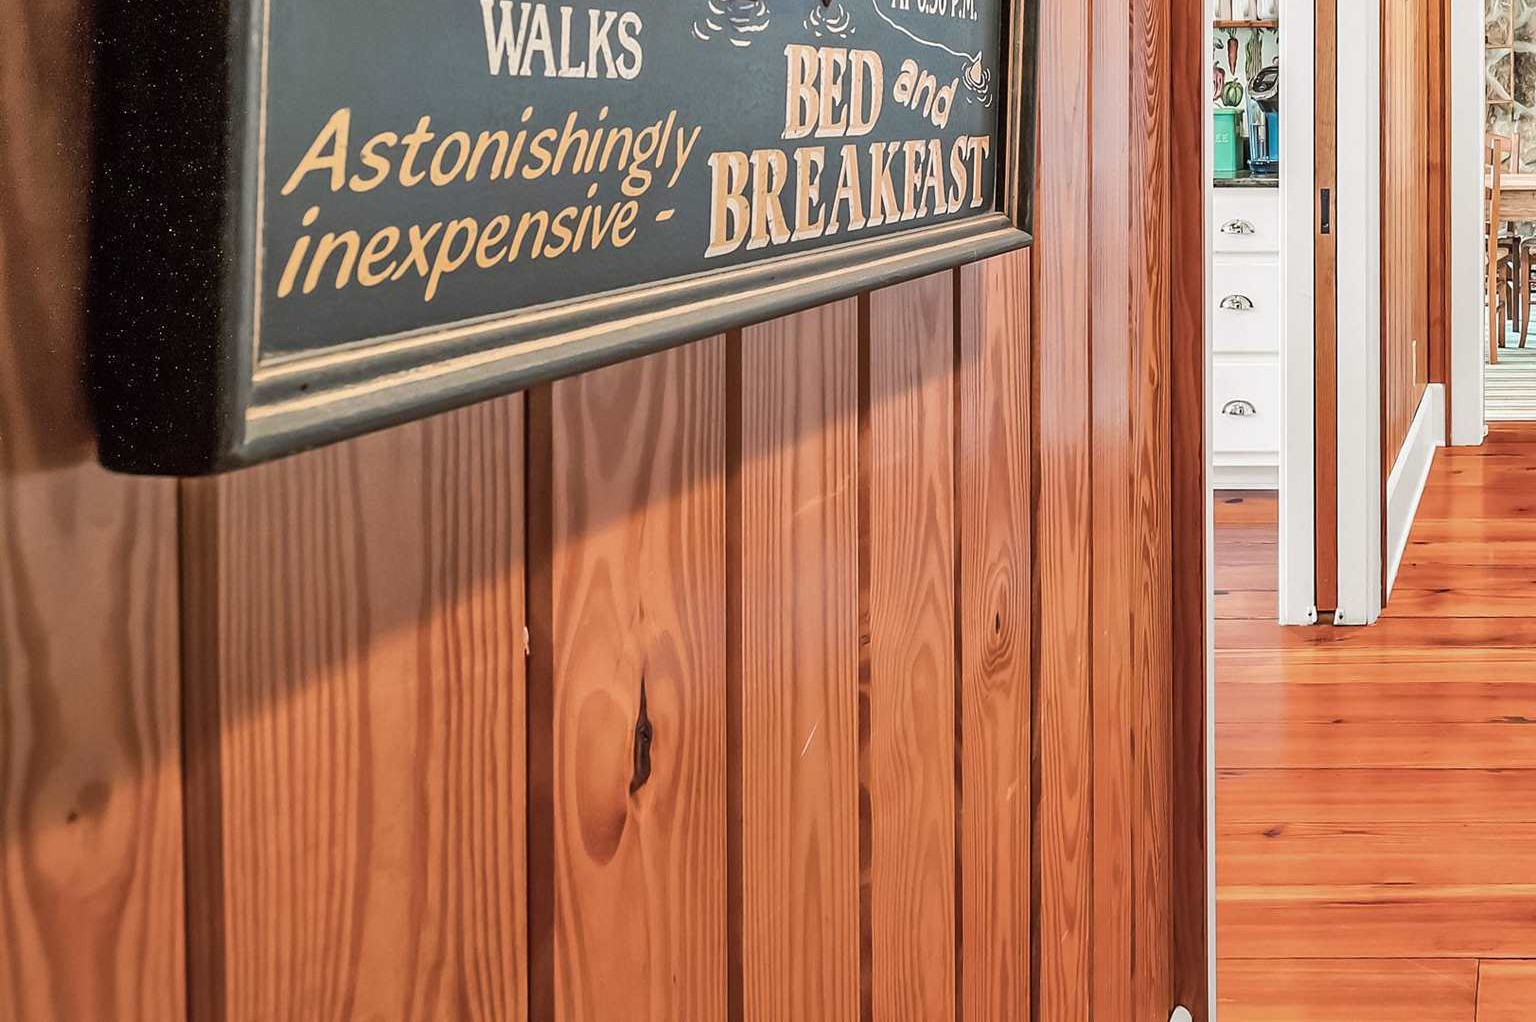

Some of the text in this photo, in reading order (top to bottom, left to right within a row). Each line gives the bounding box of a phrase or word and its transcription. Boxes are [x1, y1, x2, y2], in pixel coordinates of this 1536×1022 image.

[780, 43, 960, 142] BED and
[280, 106, 703, 197] Astonishingly
[704, 135, 992, 259] BREAKFAST
[277, 184, 638, 303] inexpensive
